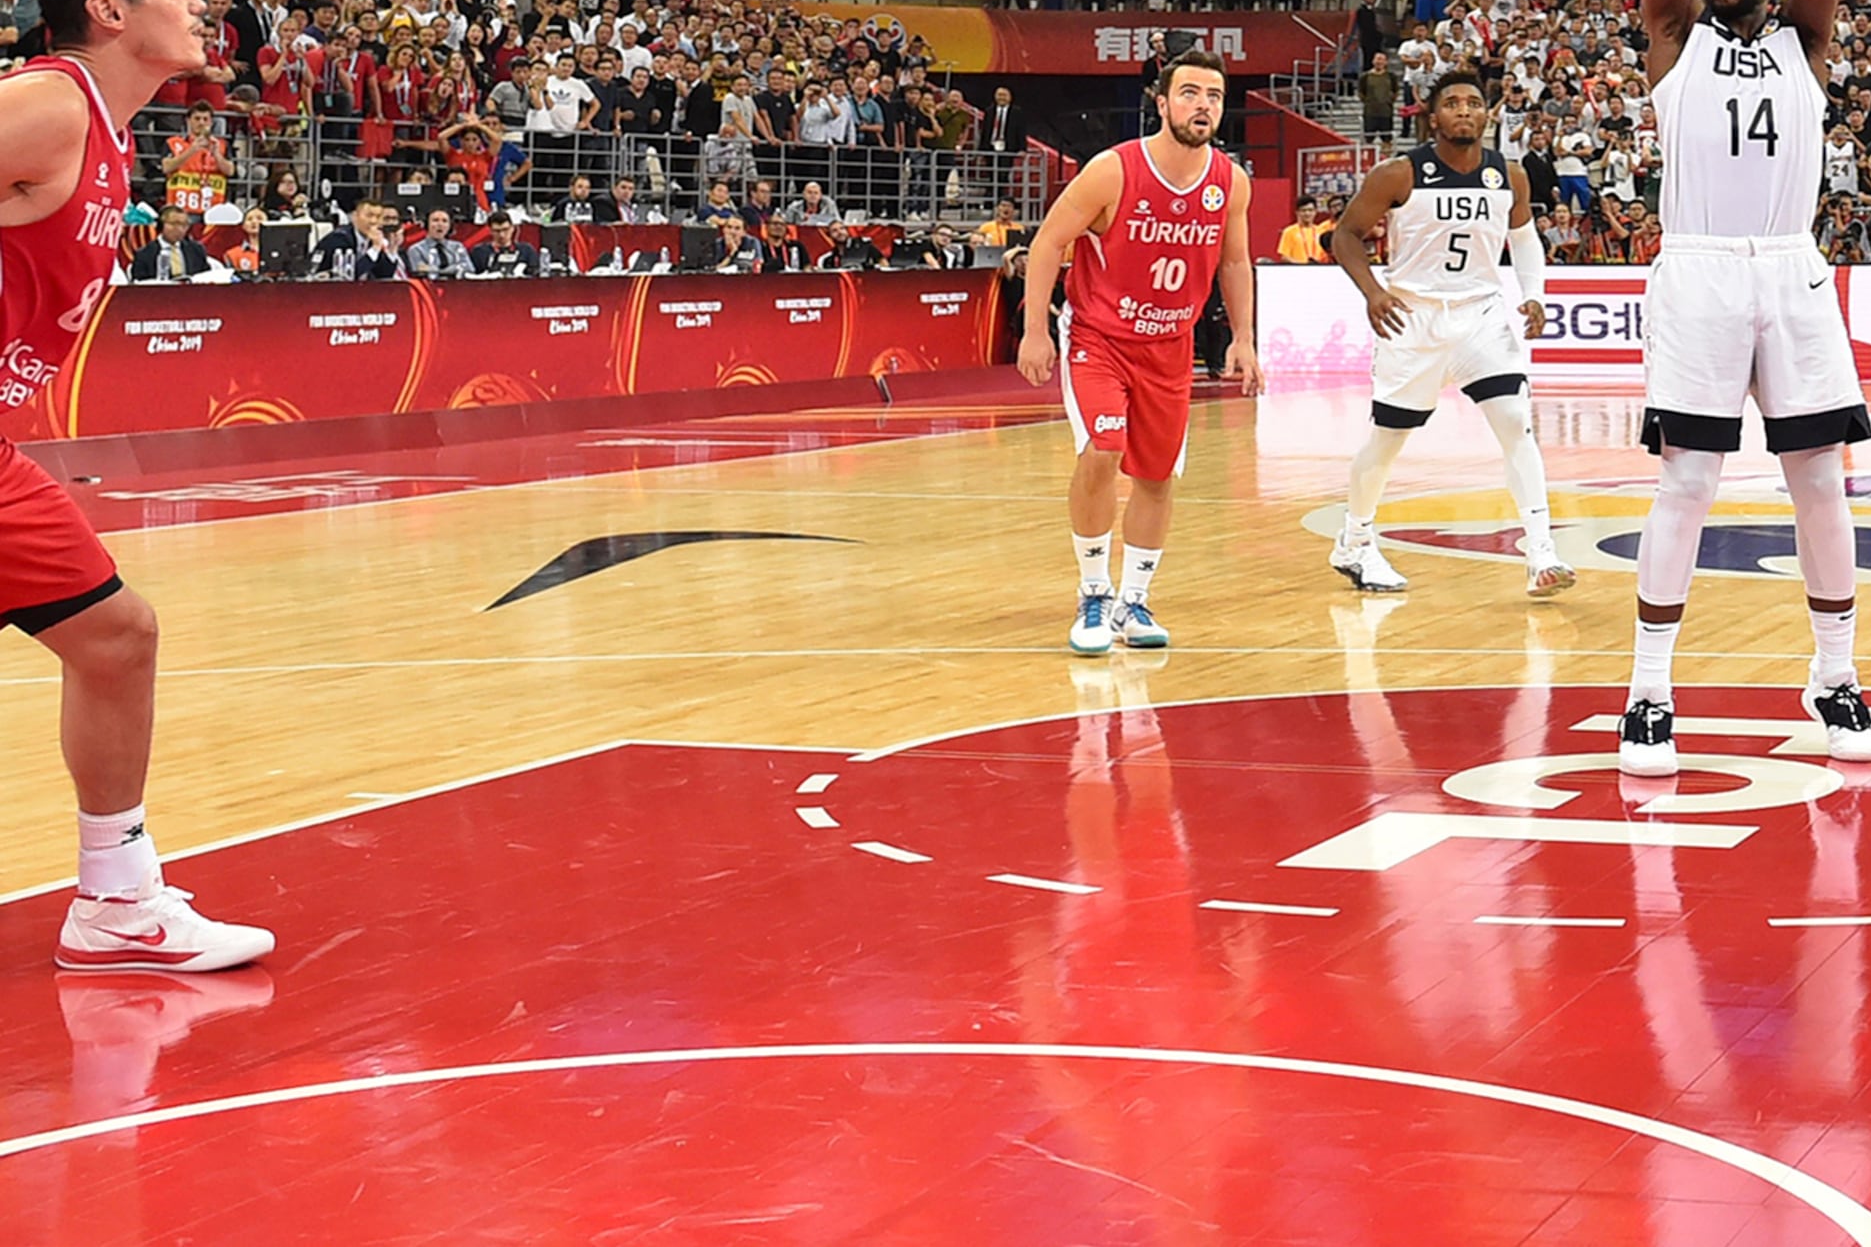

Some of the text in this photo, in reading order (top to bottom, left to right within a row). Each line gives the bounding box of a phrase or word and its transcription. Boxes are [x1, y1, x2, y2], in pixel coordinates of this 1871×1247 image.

[1713, 47, 1783, 79] USA
[1726, 98, 1779, 157] 14
[1832, 164, 1848, 177] 24
[1436, 196, 1490, 221] USA
[1126, 215, 1221, 245] TÜRKİYE
[1445, 233, 1471, 272] 5
[1150, 257, 1187, 291] 10
[57, 278, 104, 332] 8
[1138, 302, 1195, 321] Garanti
[1133, 319, 1177, 336] BBVA
